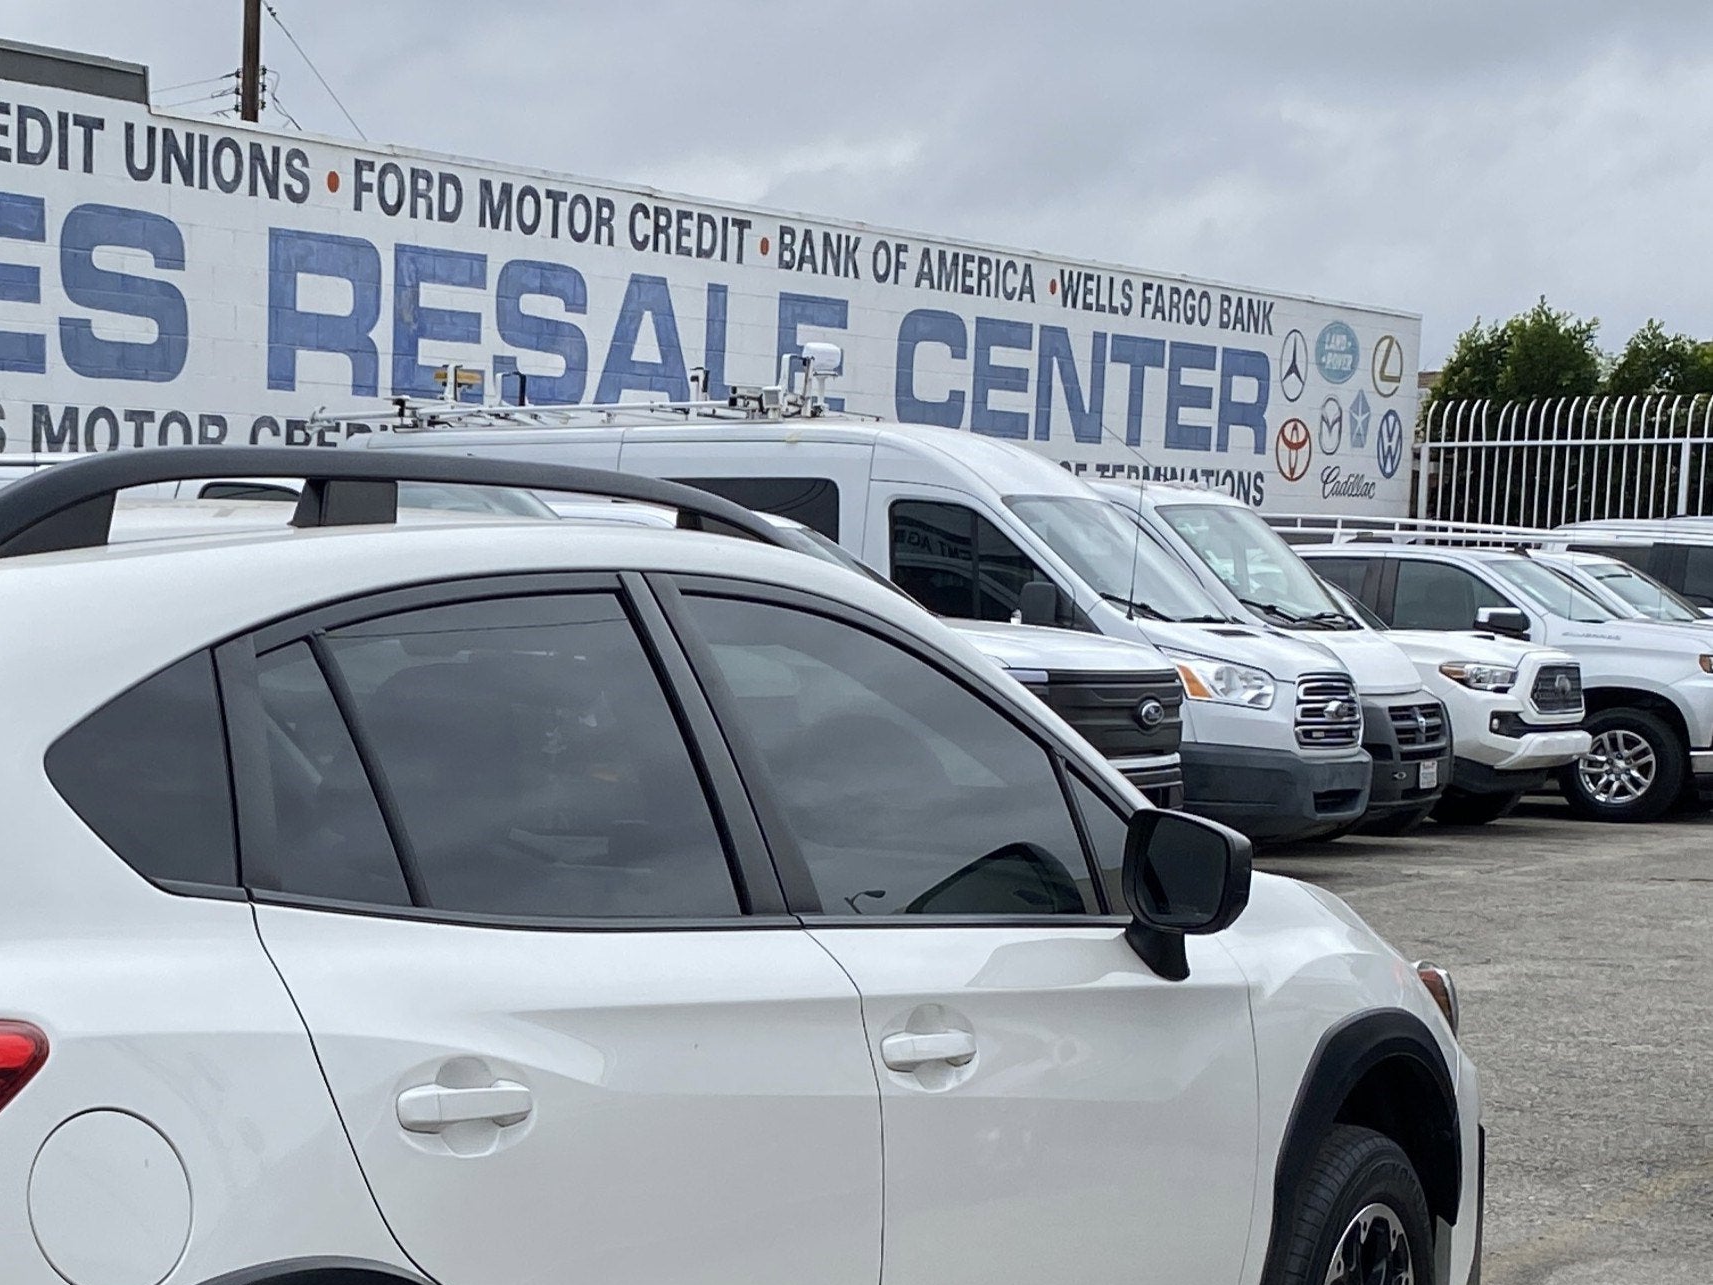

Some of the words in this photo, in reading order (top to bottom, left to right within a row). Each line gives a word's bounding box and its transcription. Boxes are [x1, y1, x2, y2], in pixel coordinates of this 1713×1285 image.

[124, 121, 311, 205] UNIONS
[353, 157, 463, 223] FORD
[478, 178, 614, 247] MOTOR
[629, 203, 753, 264] CREDIT
[778, 224, 862, 280] BANK
[872, 239, 907, 286] OF
[915, 246, 1036, 304] AMERICA
[1059, 268, 1134, 318] WELLS
[1140, 282, 1212, 327] FARGO
[1218, 294, 1274, 337] BANK
[266, 226, 849, 412] RESALE
[894, 308, 1272, 456] CENTER
[31, 403, 229, 453] MOTOR
[1321, 466, 1376, 500] Cadillac
